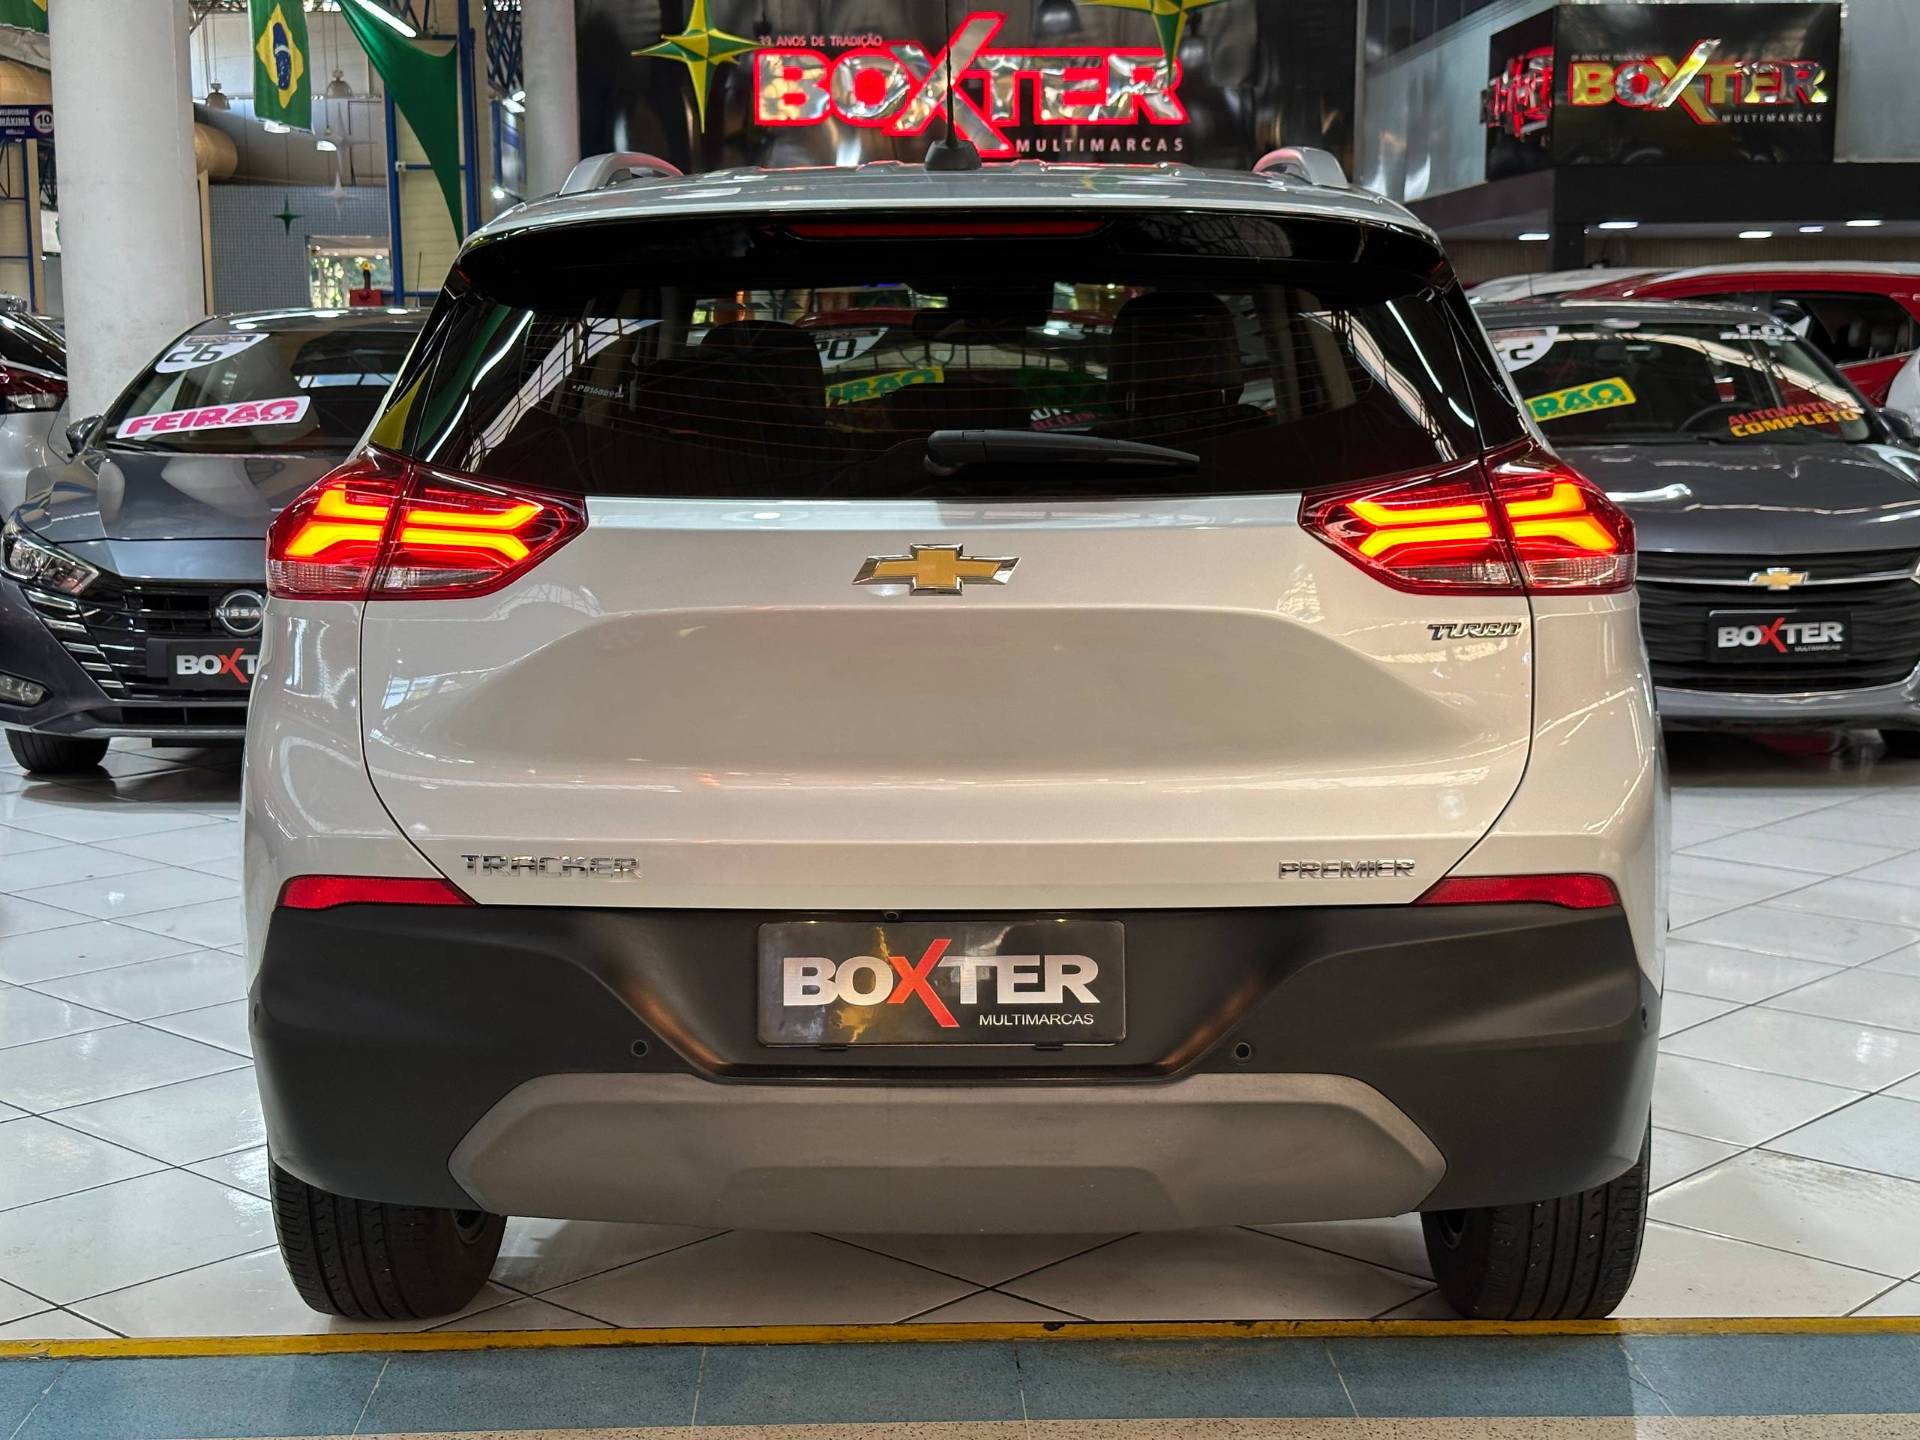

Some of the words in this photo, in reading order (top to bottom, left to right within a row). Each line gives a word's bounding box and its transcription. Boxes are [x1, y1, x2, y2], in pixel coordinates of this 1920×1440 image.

[776, 35, 806, 46] ANOS
[811, 35, 825, 46] DE
[830, 32, 882, 47] TRADIÇÃO
[754, 12, 1189, 157] BOXTER
[1568, 38, 1828, 125] BOXTER
[36, 114, 52, 124] 10
[1722, 112, 1823, 123] MULTIMARCAS
[1016, 137, 1184, 153] MULTIMARCAS
[1527, 383, 1627, 418] RÃO
[126, 400, 299, 434] FEIRÃO
[1730, 410, 1860, 438] COMPLETO
[215, 608, 262, 617] NISSA
[1427, 622, 1522, 640] TURBO
[1718, 617, 1845, 653] BOXTER
[460, 854, 643, 879] TRACKER
[1279, 859, 1416, 880] PREMIER
[782, 938, 1101, 1028] BOXTER
[979, 1013, 1095, 1025] MULTIMARCAS
